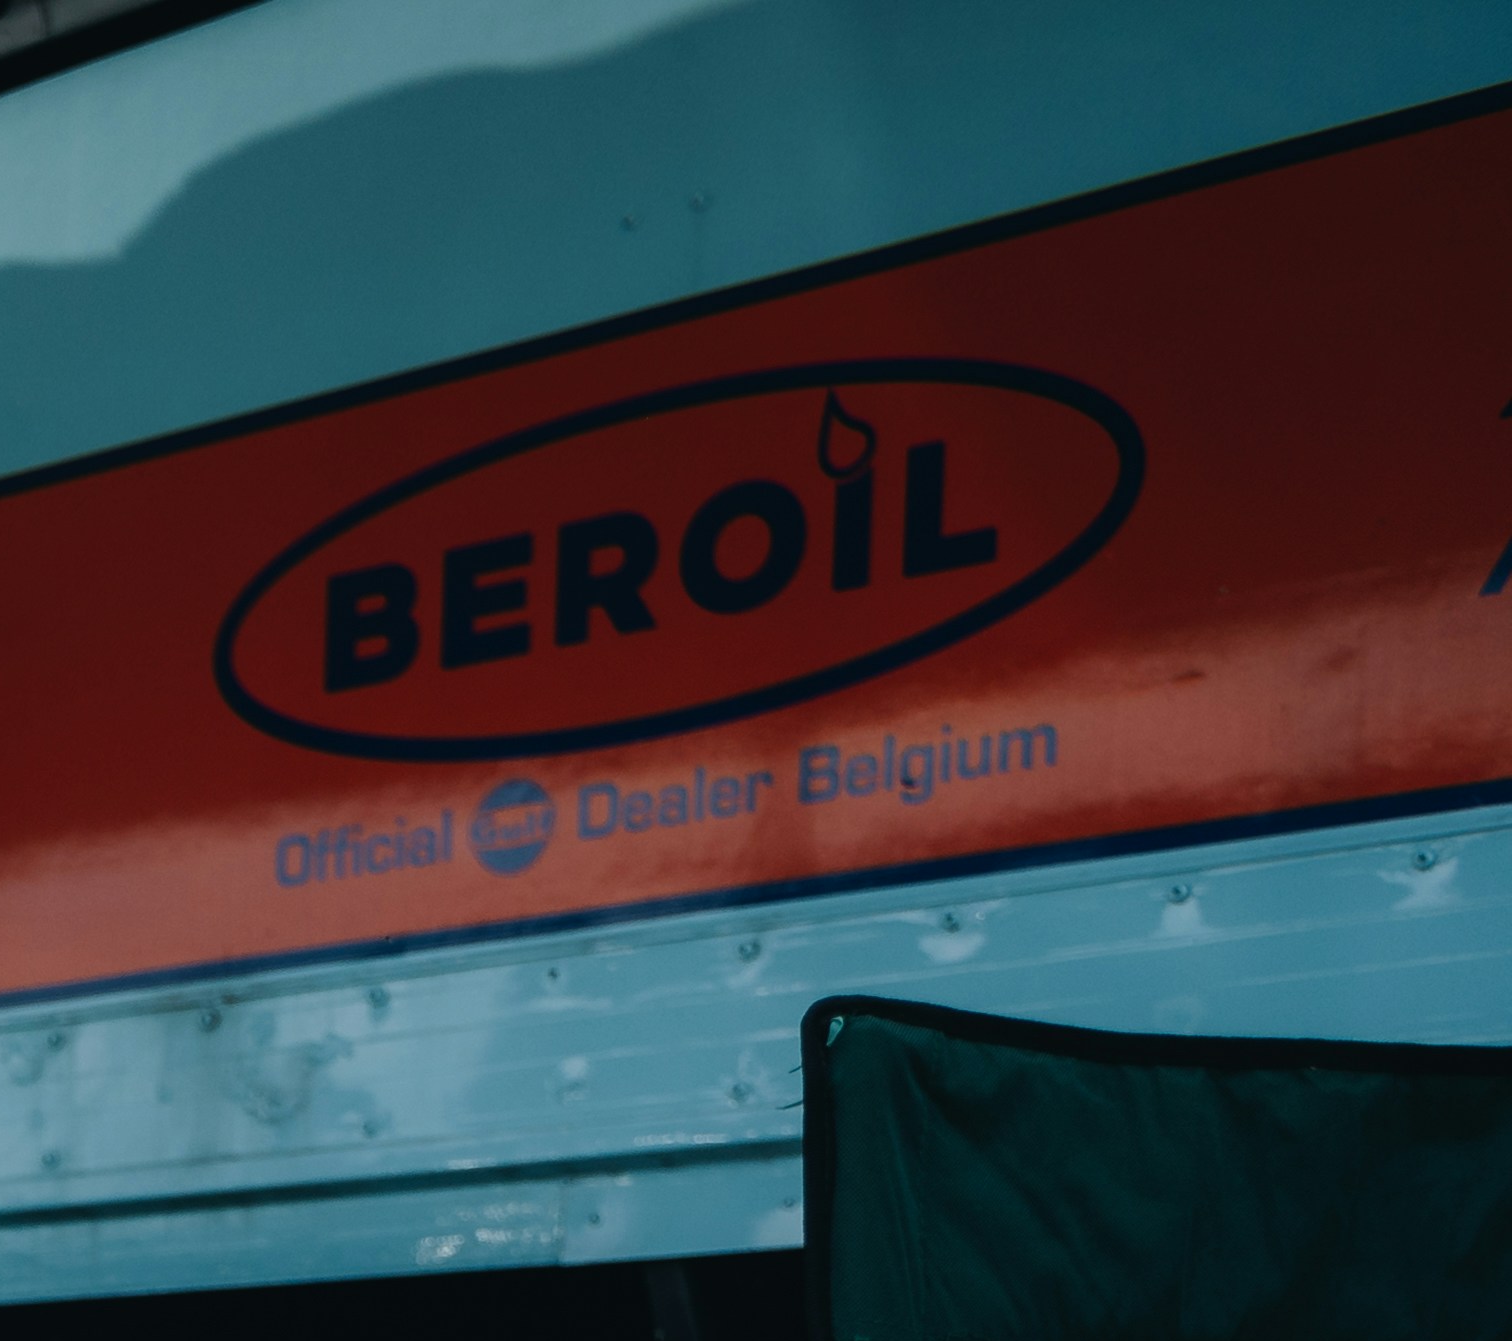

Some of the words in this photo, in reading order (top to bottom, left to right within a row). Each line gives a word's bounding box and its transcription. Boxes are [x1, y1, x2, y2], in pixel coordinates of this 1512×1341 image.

[323, 440, 999, 694] BEROIL
[275, 811, 453, 888] Official
[577, 767, 773, 841] Dealer
[797, 724, 1059, 804] Belgium
